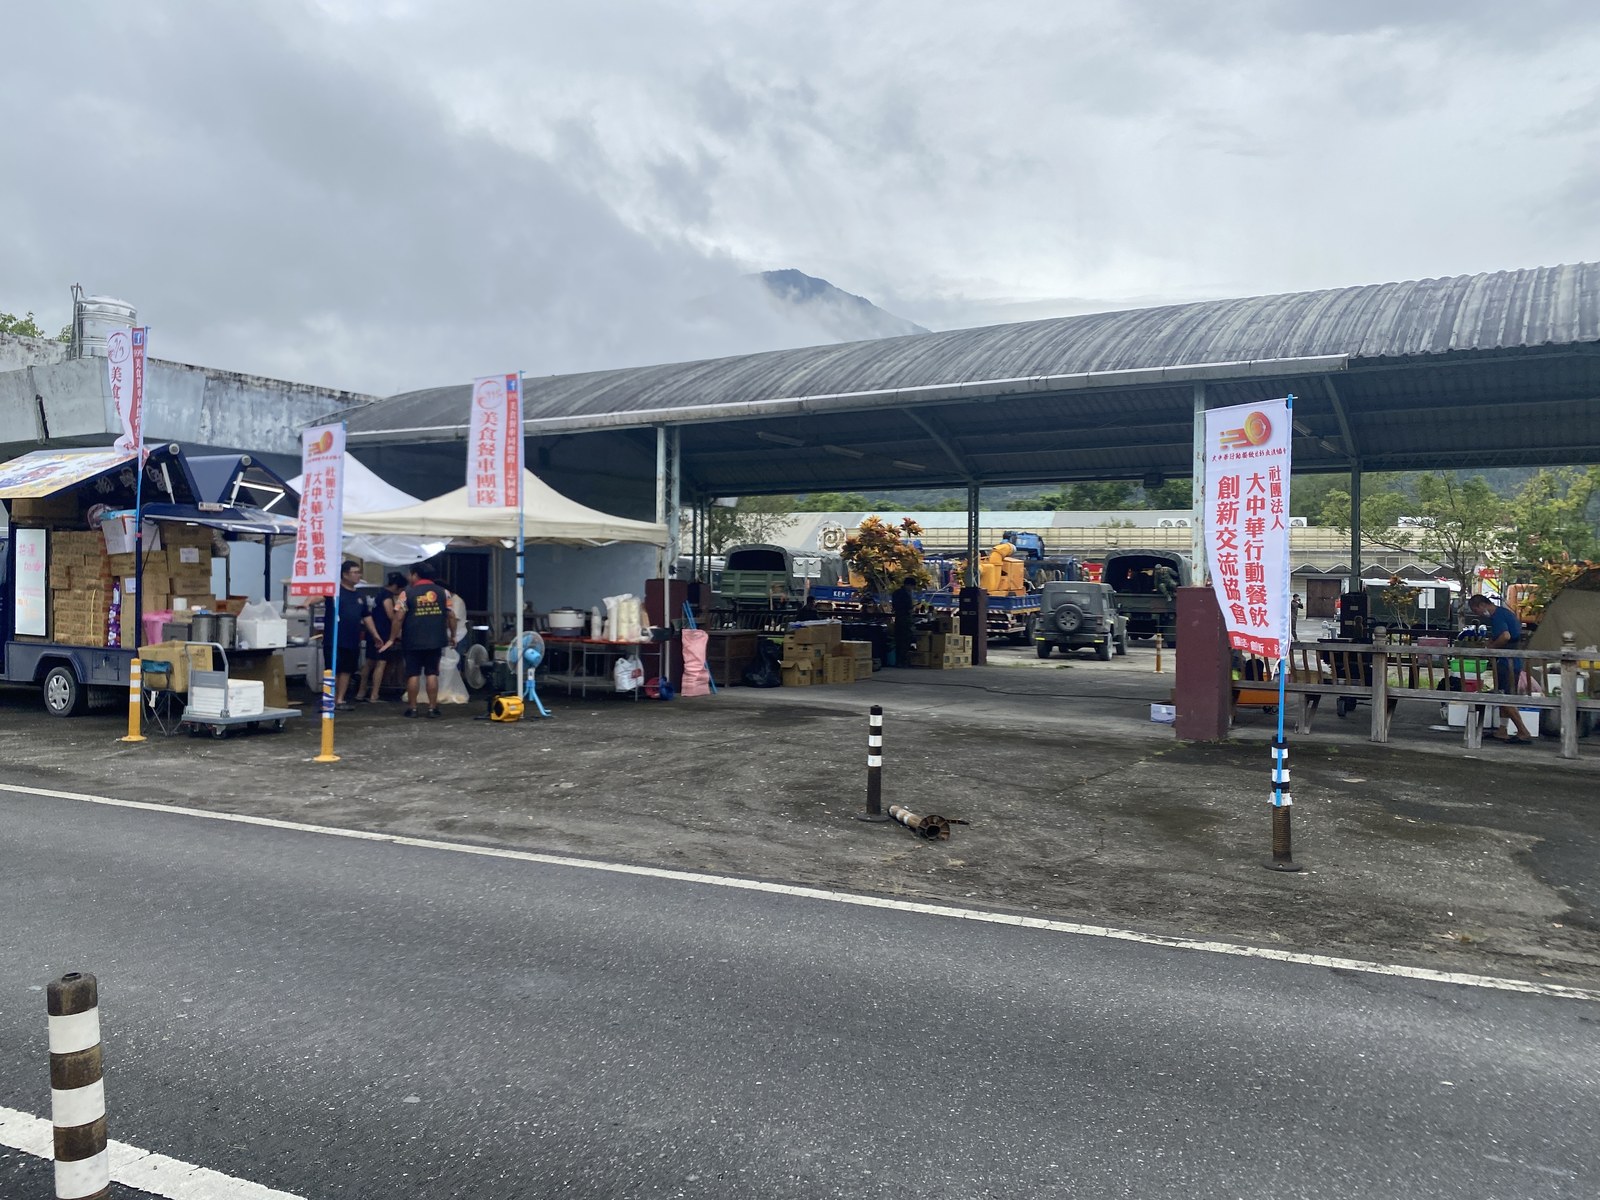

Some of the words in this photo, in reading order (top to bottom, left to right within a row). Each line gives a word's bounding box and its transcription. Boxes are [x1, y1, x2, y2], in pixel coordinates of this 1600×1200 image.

[477, 411, 498, 505] 美食餐車團隊
[1269, 465, 1284, 530] 社團法人
[310, 472, 326, 576] 大中華行動餐飲
[1216, 475, 1248, 625] 創新交流協會
[1244, 472, 1269, 628] 大中華行動餐飲
